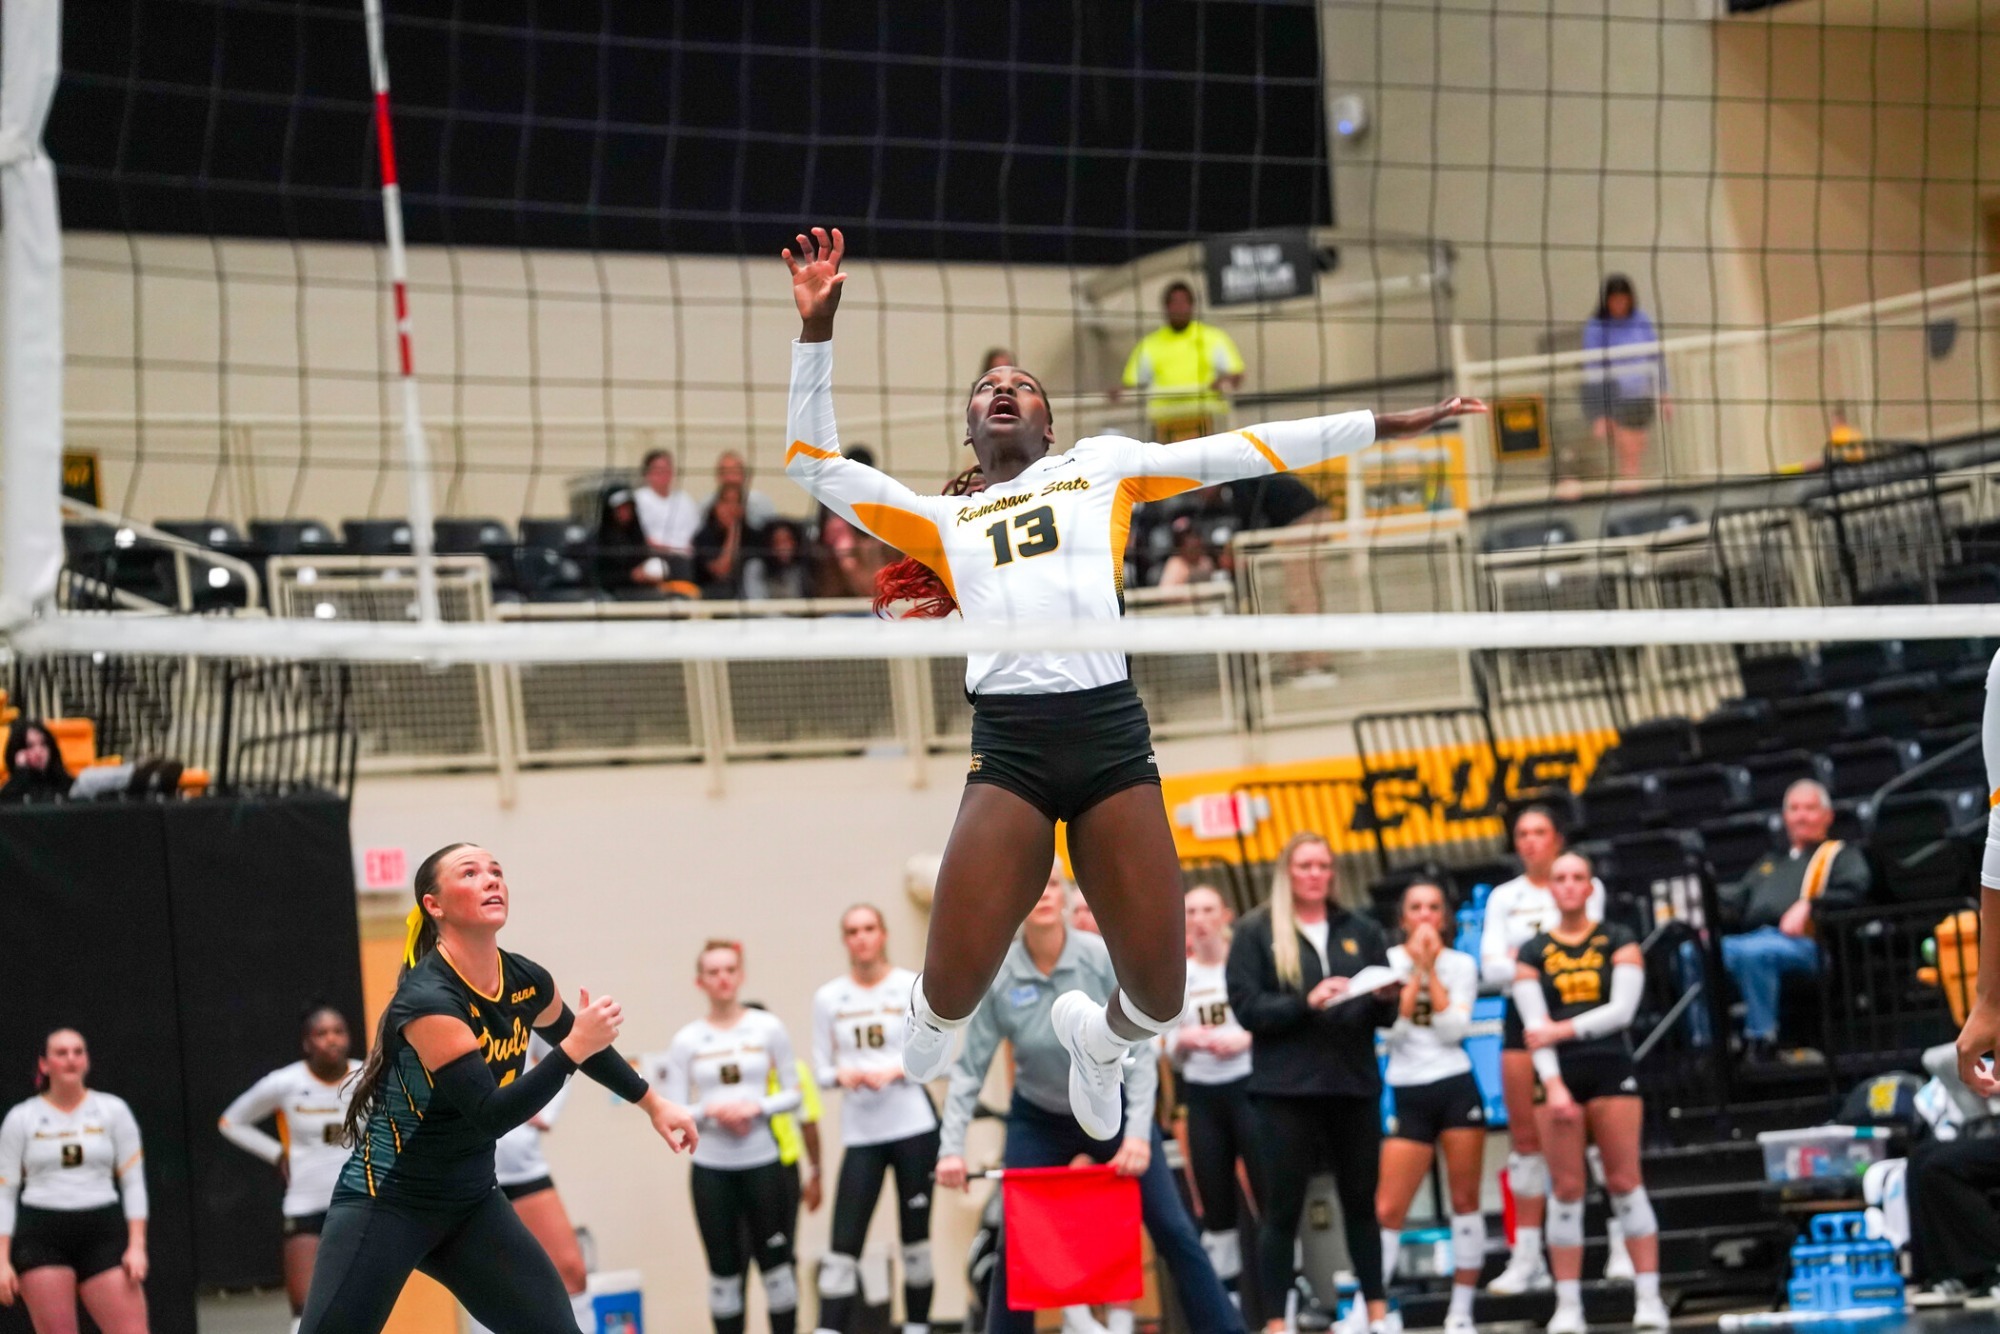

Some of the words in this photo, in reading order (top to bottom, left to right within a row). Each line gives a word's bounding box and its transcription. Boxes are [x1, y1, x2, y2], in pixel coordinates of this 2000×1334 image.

[957, 492, 1034, 527] Kennesaw
[1041, 477, 1091, 497] State
[985, 504, 1060, 568] 13
